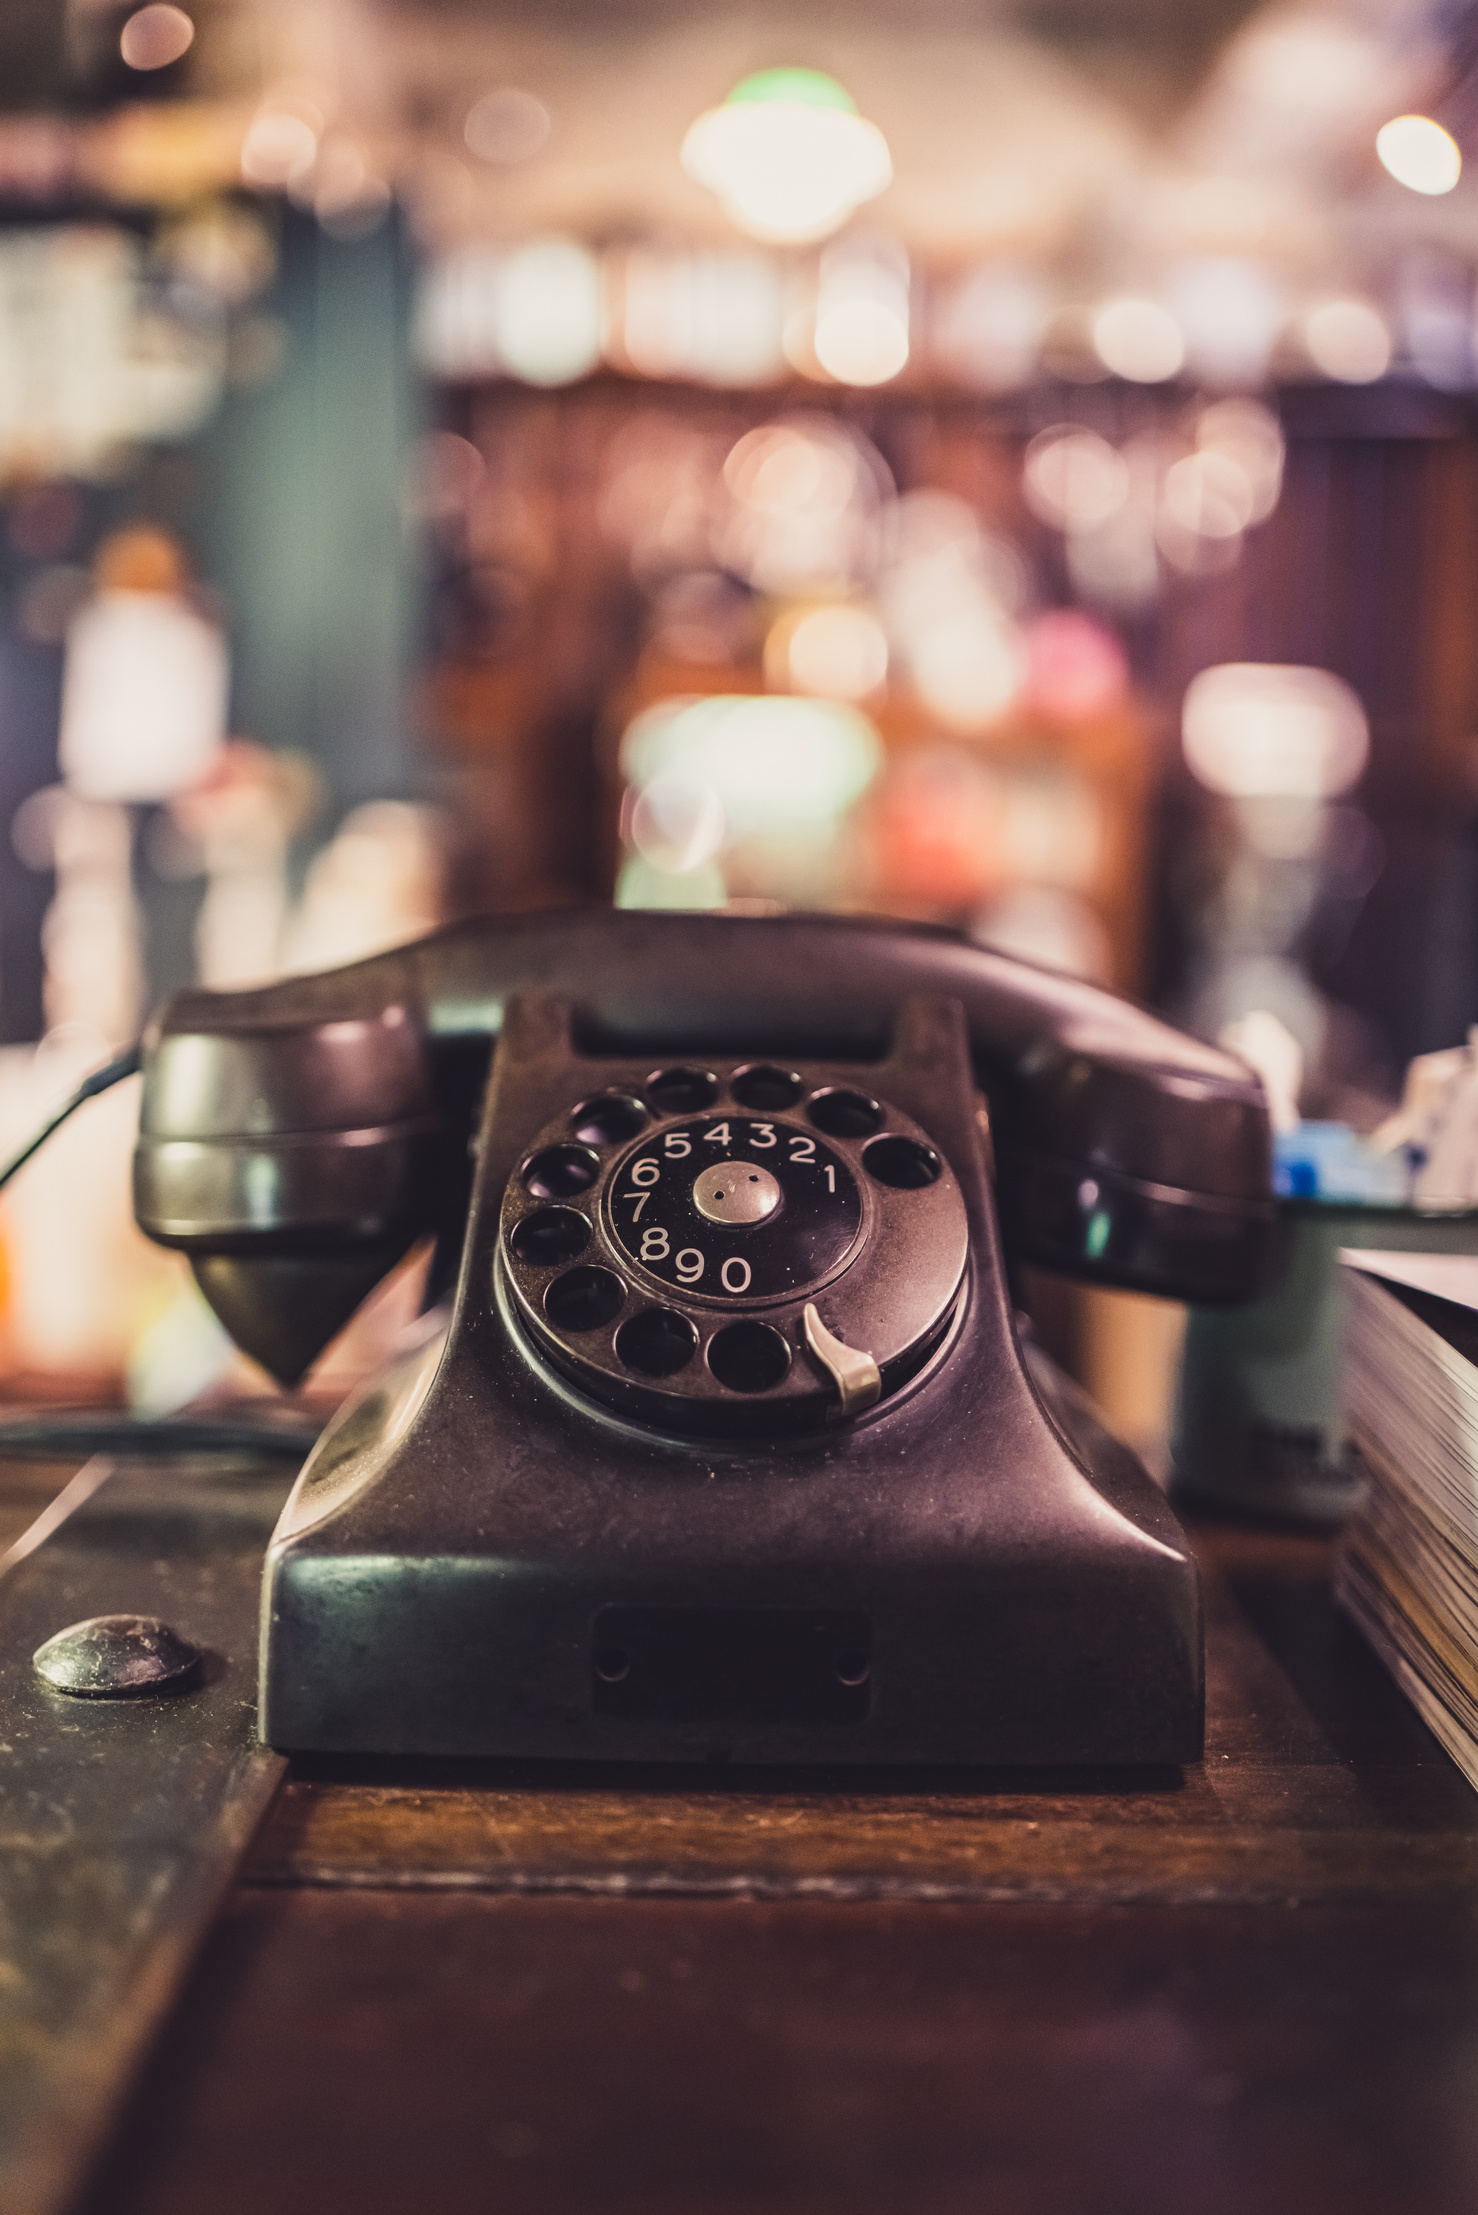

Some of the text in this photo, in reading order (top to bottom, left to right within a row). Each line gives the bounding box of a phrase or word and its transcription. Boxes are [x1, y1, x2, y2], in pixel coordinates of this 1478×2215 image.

[664, 1132, 692, 1158] 5
[703, 1122, 732, 1146] 4
[749, 1123, 777, 1148] 3
[788, 1137, 816, 1164] 2
[631, 1158, 660, 1186] 6
[824, 1164, 836, 1193] 1
[623, 1191, 650, 1222] 7
[640, 1227, 670, 1261] 8
[675, 1248, 705, 1283] 9
[721, 1257, 751, 1293] 0
